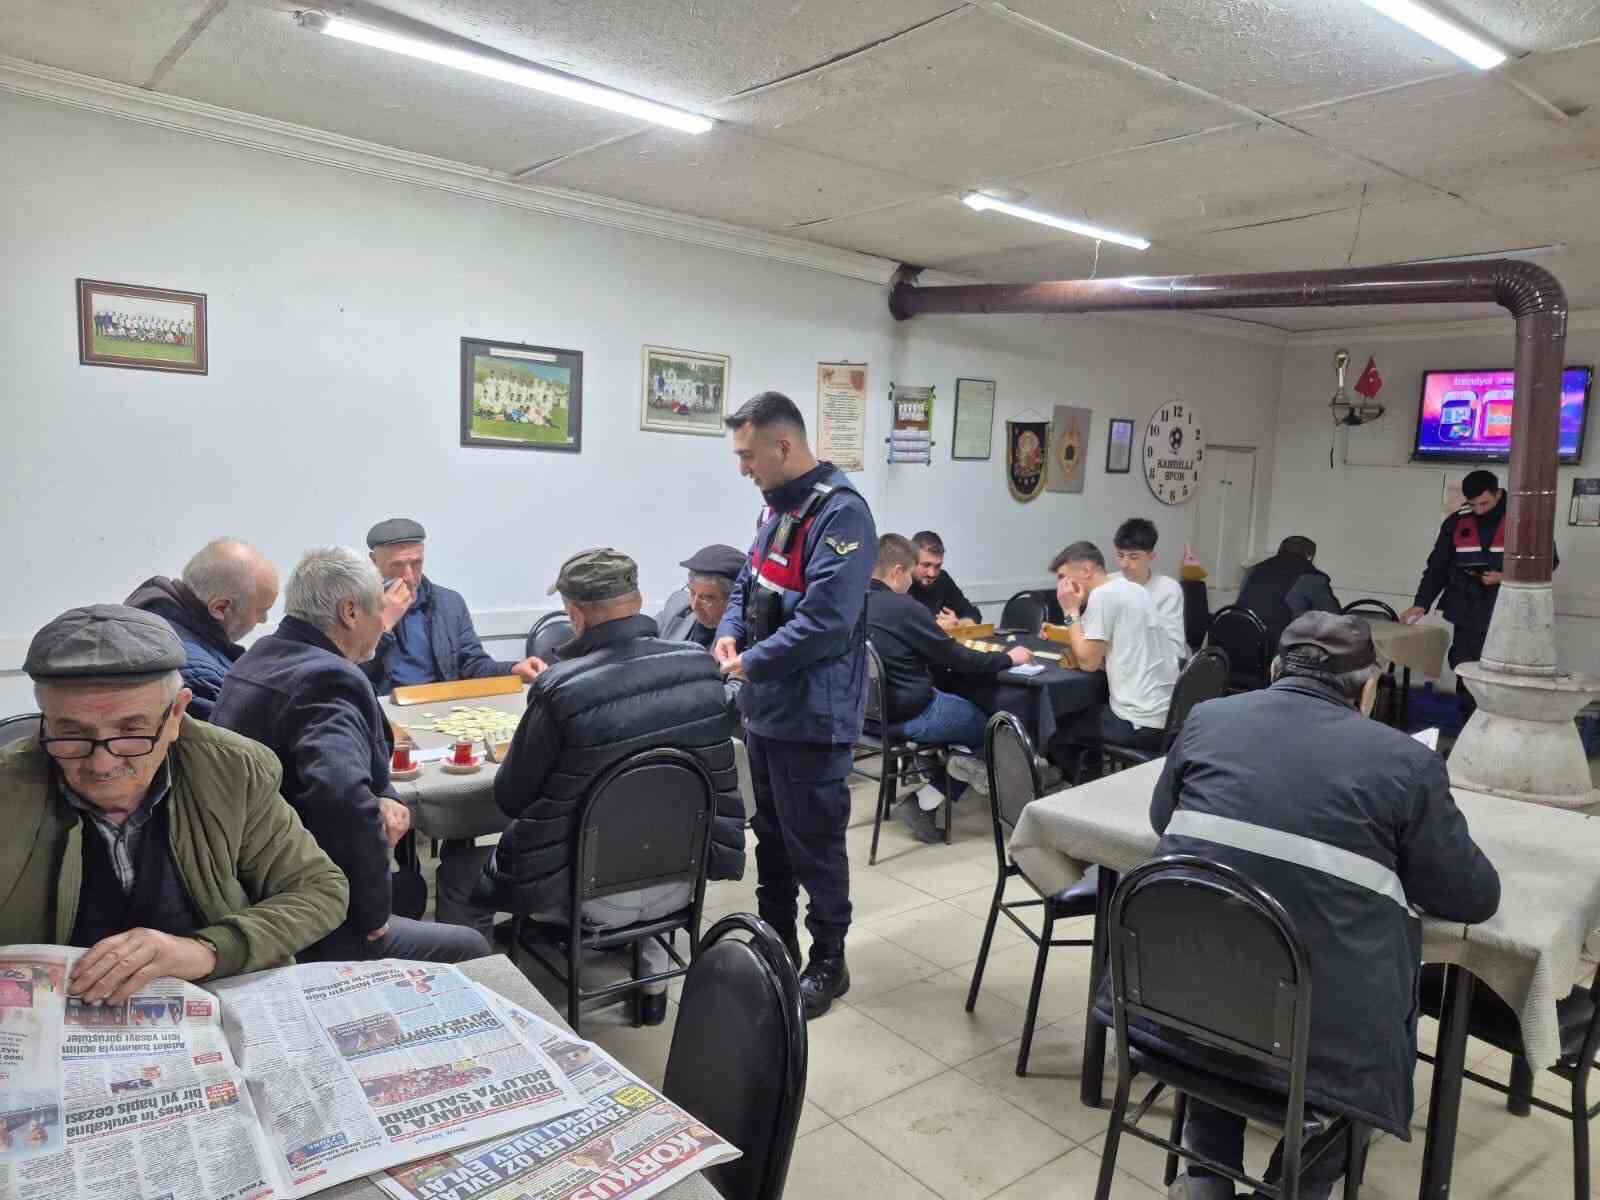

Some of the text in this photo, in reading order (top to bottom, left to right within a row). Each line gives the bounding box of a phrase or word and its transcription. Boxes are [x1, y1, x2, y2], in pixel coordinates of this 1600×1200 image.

[1160, 410, 1169, 422] 11
[1173, 405, 1183, 418] 12
[1188, 412, 1192, 424] 1
[1150, 424, 1160, 437] 10
[1195, 428, 1201, 440] 2
[1147, 446, 1153, 458] 9
[1196, 449, 1203, 461] 3
[1149, 467, 1156, 479] 8
[1158, 484, 1164, 495] 7
[1182, 485, 1188, 496] 5
[1169, 490, 1176, 502] 6
[488, 1080, 560, 1108] TRUMP
[116, 1094, 157, 1114] hapis
[375, 1090, 471, 1127] SALDIRDI
[64, 1104, 114, 1124] cezası
[383, 1123, 404, 1138] O
